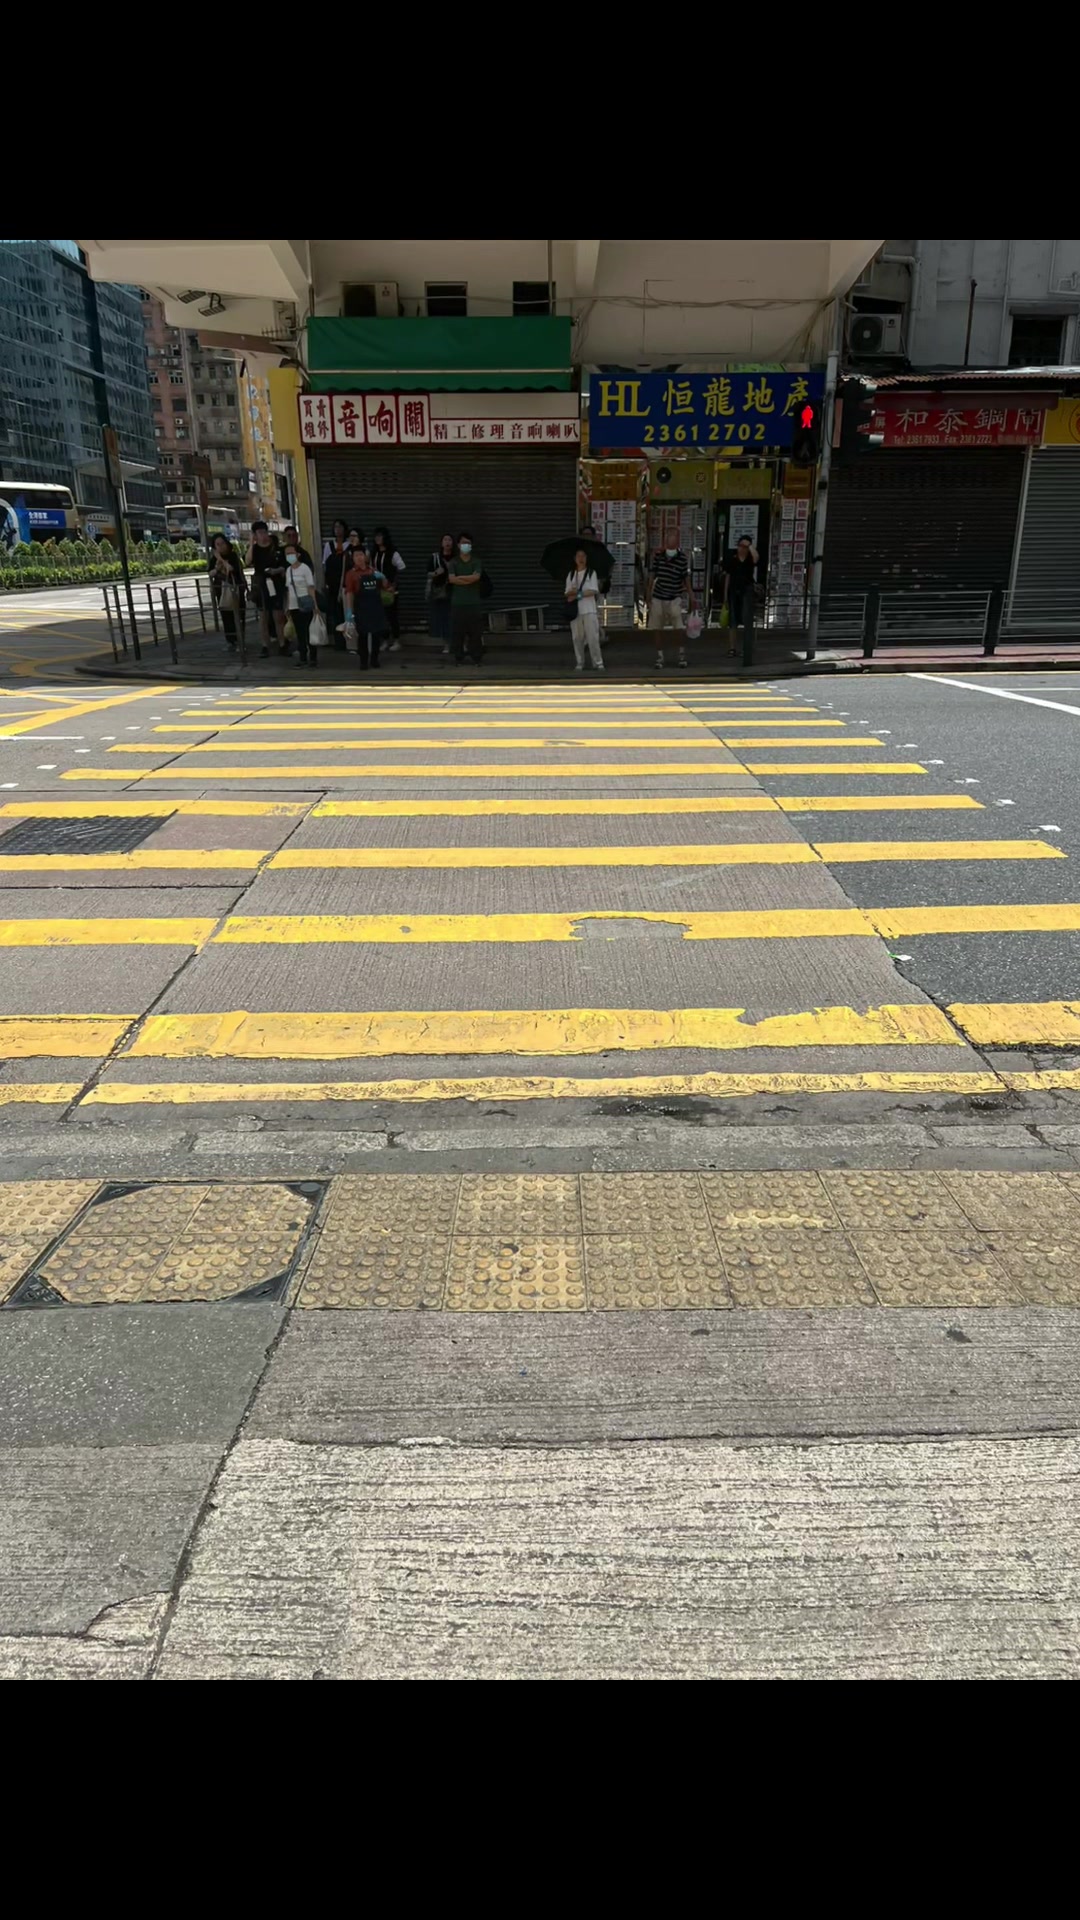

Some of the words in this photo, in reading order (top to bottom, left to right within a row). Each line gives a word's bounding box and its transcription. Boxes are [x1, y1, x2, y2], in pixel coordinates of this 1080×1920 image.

[598, 380, 651, 416] HL
[662, 376, 809, 417] 恒龍地產
[433, 422, 579, 440] 精工修理音响喇叭
[895, 408, 1042, 433] 和泰鋼閘
[643, 424, 698, 442] 2361
[708, 423, 766, 441] 2702
